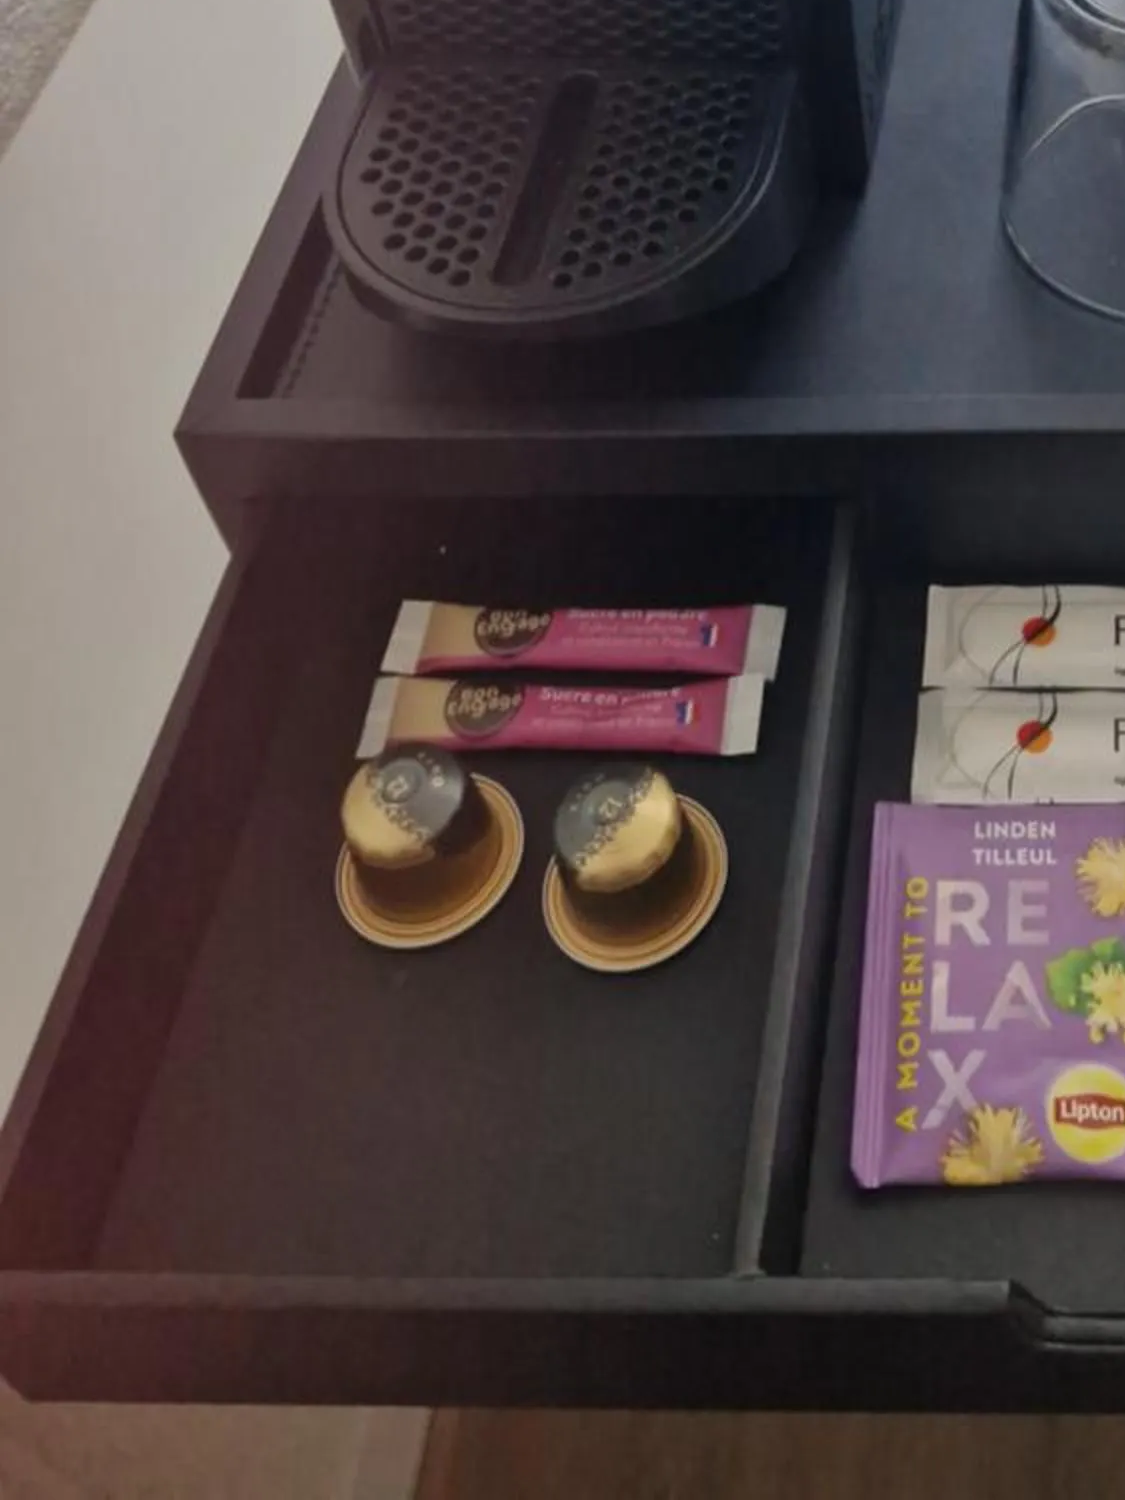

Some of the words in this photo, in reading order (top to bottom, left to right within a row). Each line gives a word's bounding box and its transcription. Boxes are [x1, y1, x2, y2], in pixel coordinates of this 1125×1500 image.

[974, 821, 1056, 839] LINDEN
[972, 847, 1057, 866] TILLEUL
[903, 876, 929, 920] TO
[895, 933, 925, 1090] MOMENT
[895, 1105, 919, 1132] A
[1060, 1101, 1125, 1123] Lipton
